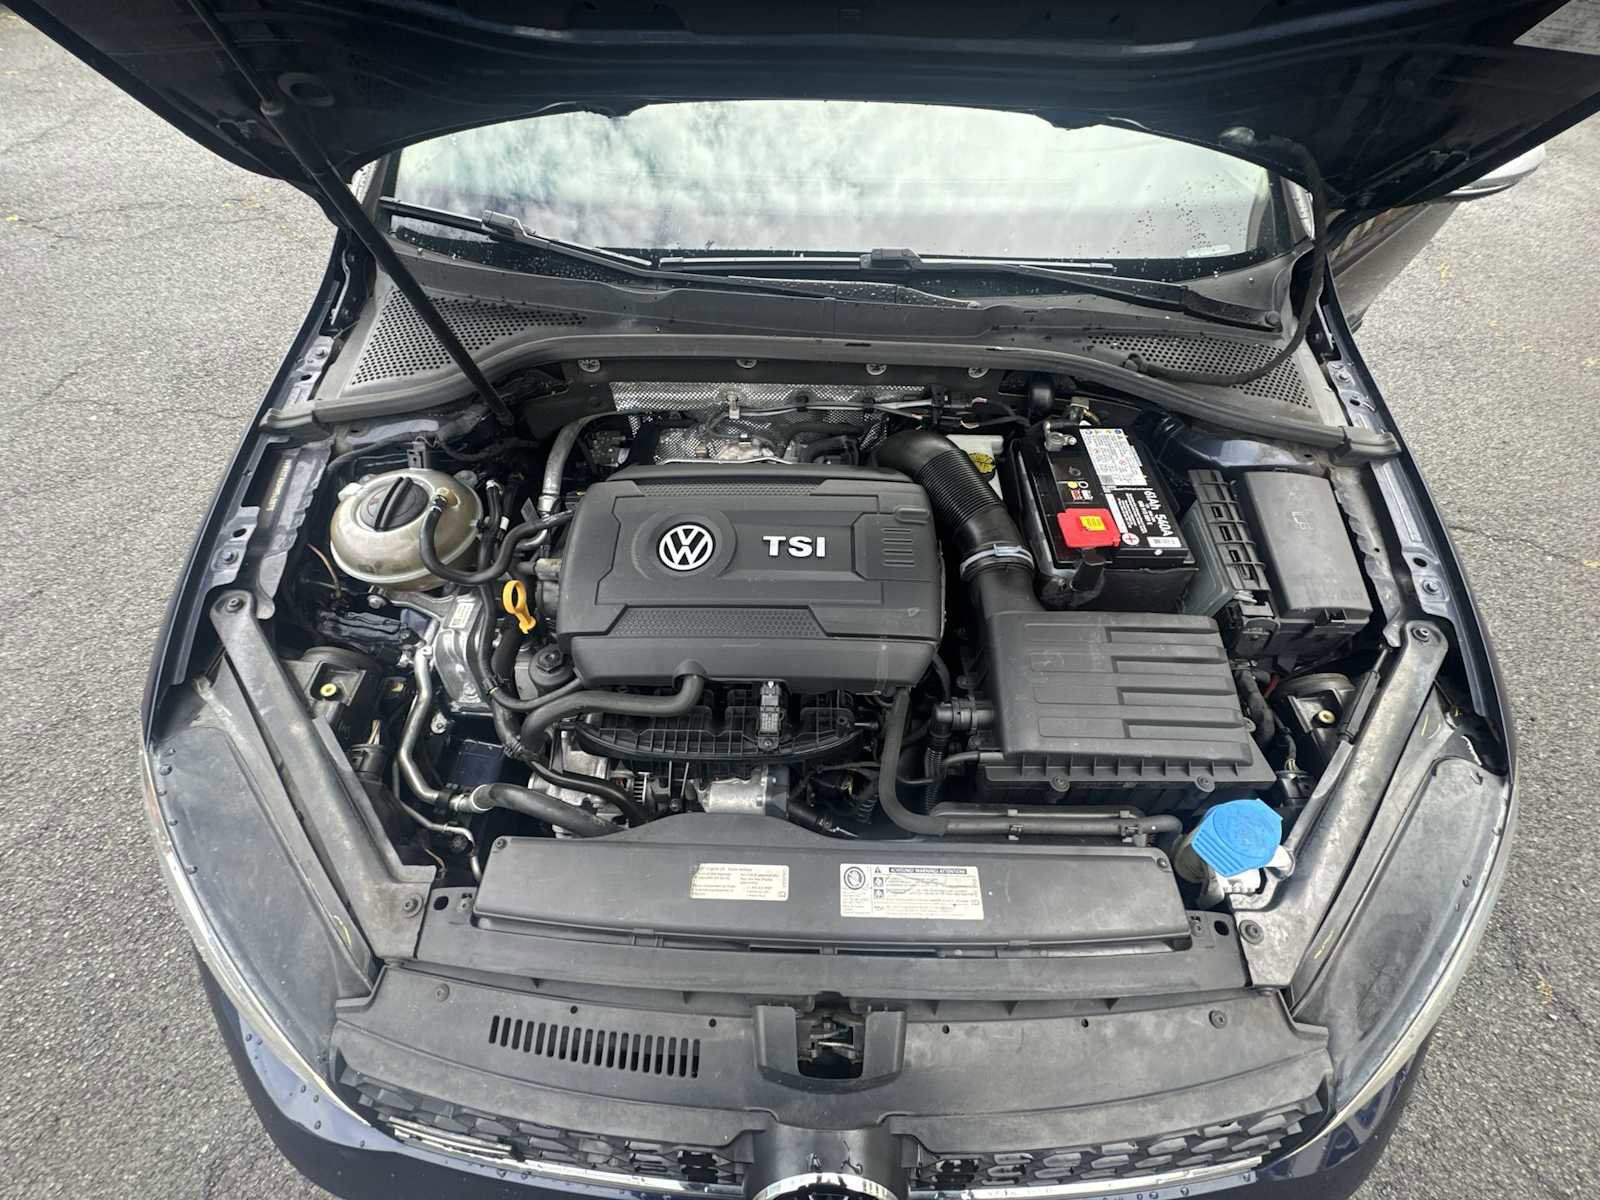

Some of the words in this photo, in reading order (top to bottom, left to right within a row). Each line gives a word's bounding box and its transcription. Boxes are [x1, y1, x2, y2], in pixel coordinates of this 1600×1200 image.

[1144, 491, 1161, 510] 61Ah
[1155, 514, 1174, 536] 540A
[658, 524, 714, 571] VW
[762, 535, 826, 558] TSI
